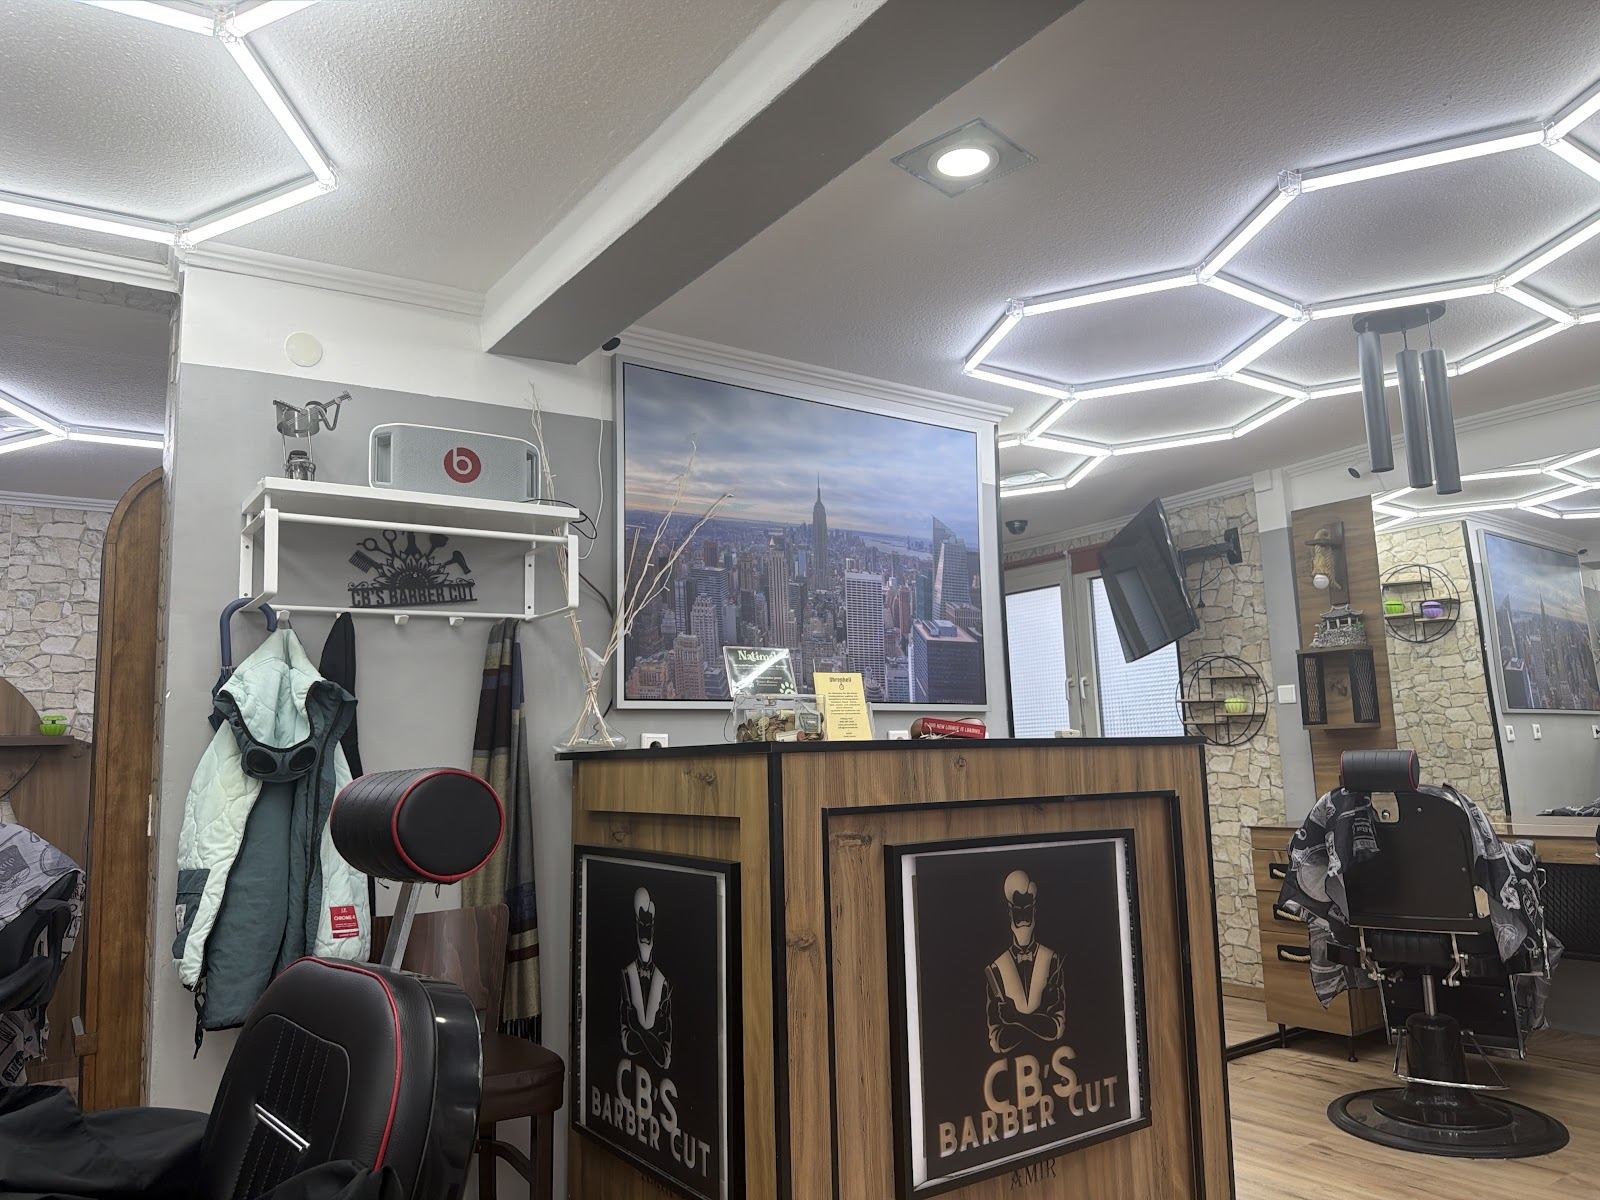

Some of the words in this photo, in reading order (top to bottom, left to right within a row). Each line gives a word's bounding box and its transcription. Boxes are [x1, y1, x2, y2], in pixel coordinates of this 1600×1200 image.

[351, 589, 385, 607] CB'S
[389, 586, 445, 606] BARBER
[449, 583, 475, 601] CUT
[616, 1058, 679, 1133] CB'S
[983, 1045, 1079, 1114] CB'S
[591, 1085, 660, 1151] BARBER
[670, 1127, 711, 1177] CUT
[938, 1094, 1056, 1158] BARBER
[1068, 1076, 1118, 1117] CUT
[1009, 1158, 1057, 1191] AMIR
